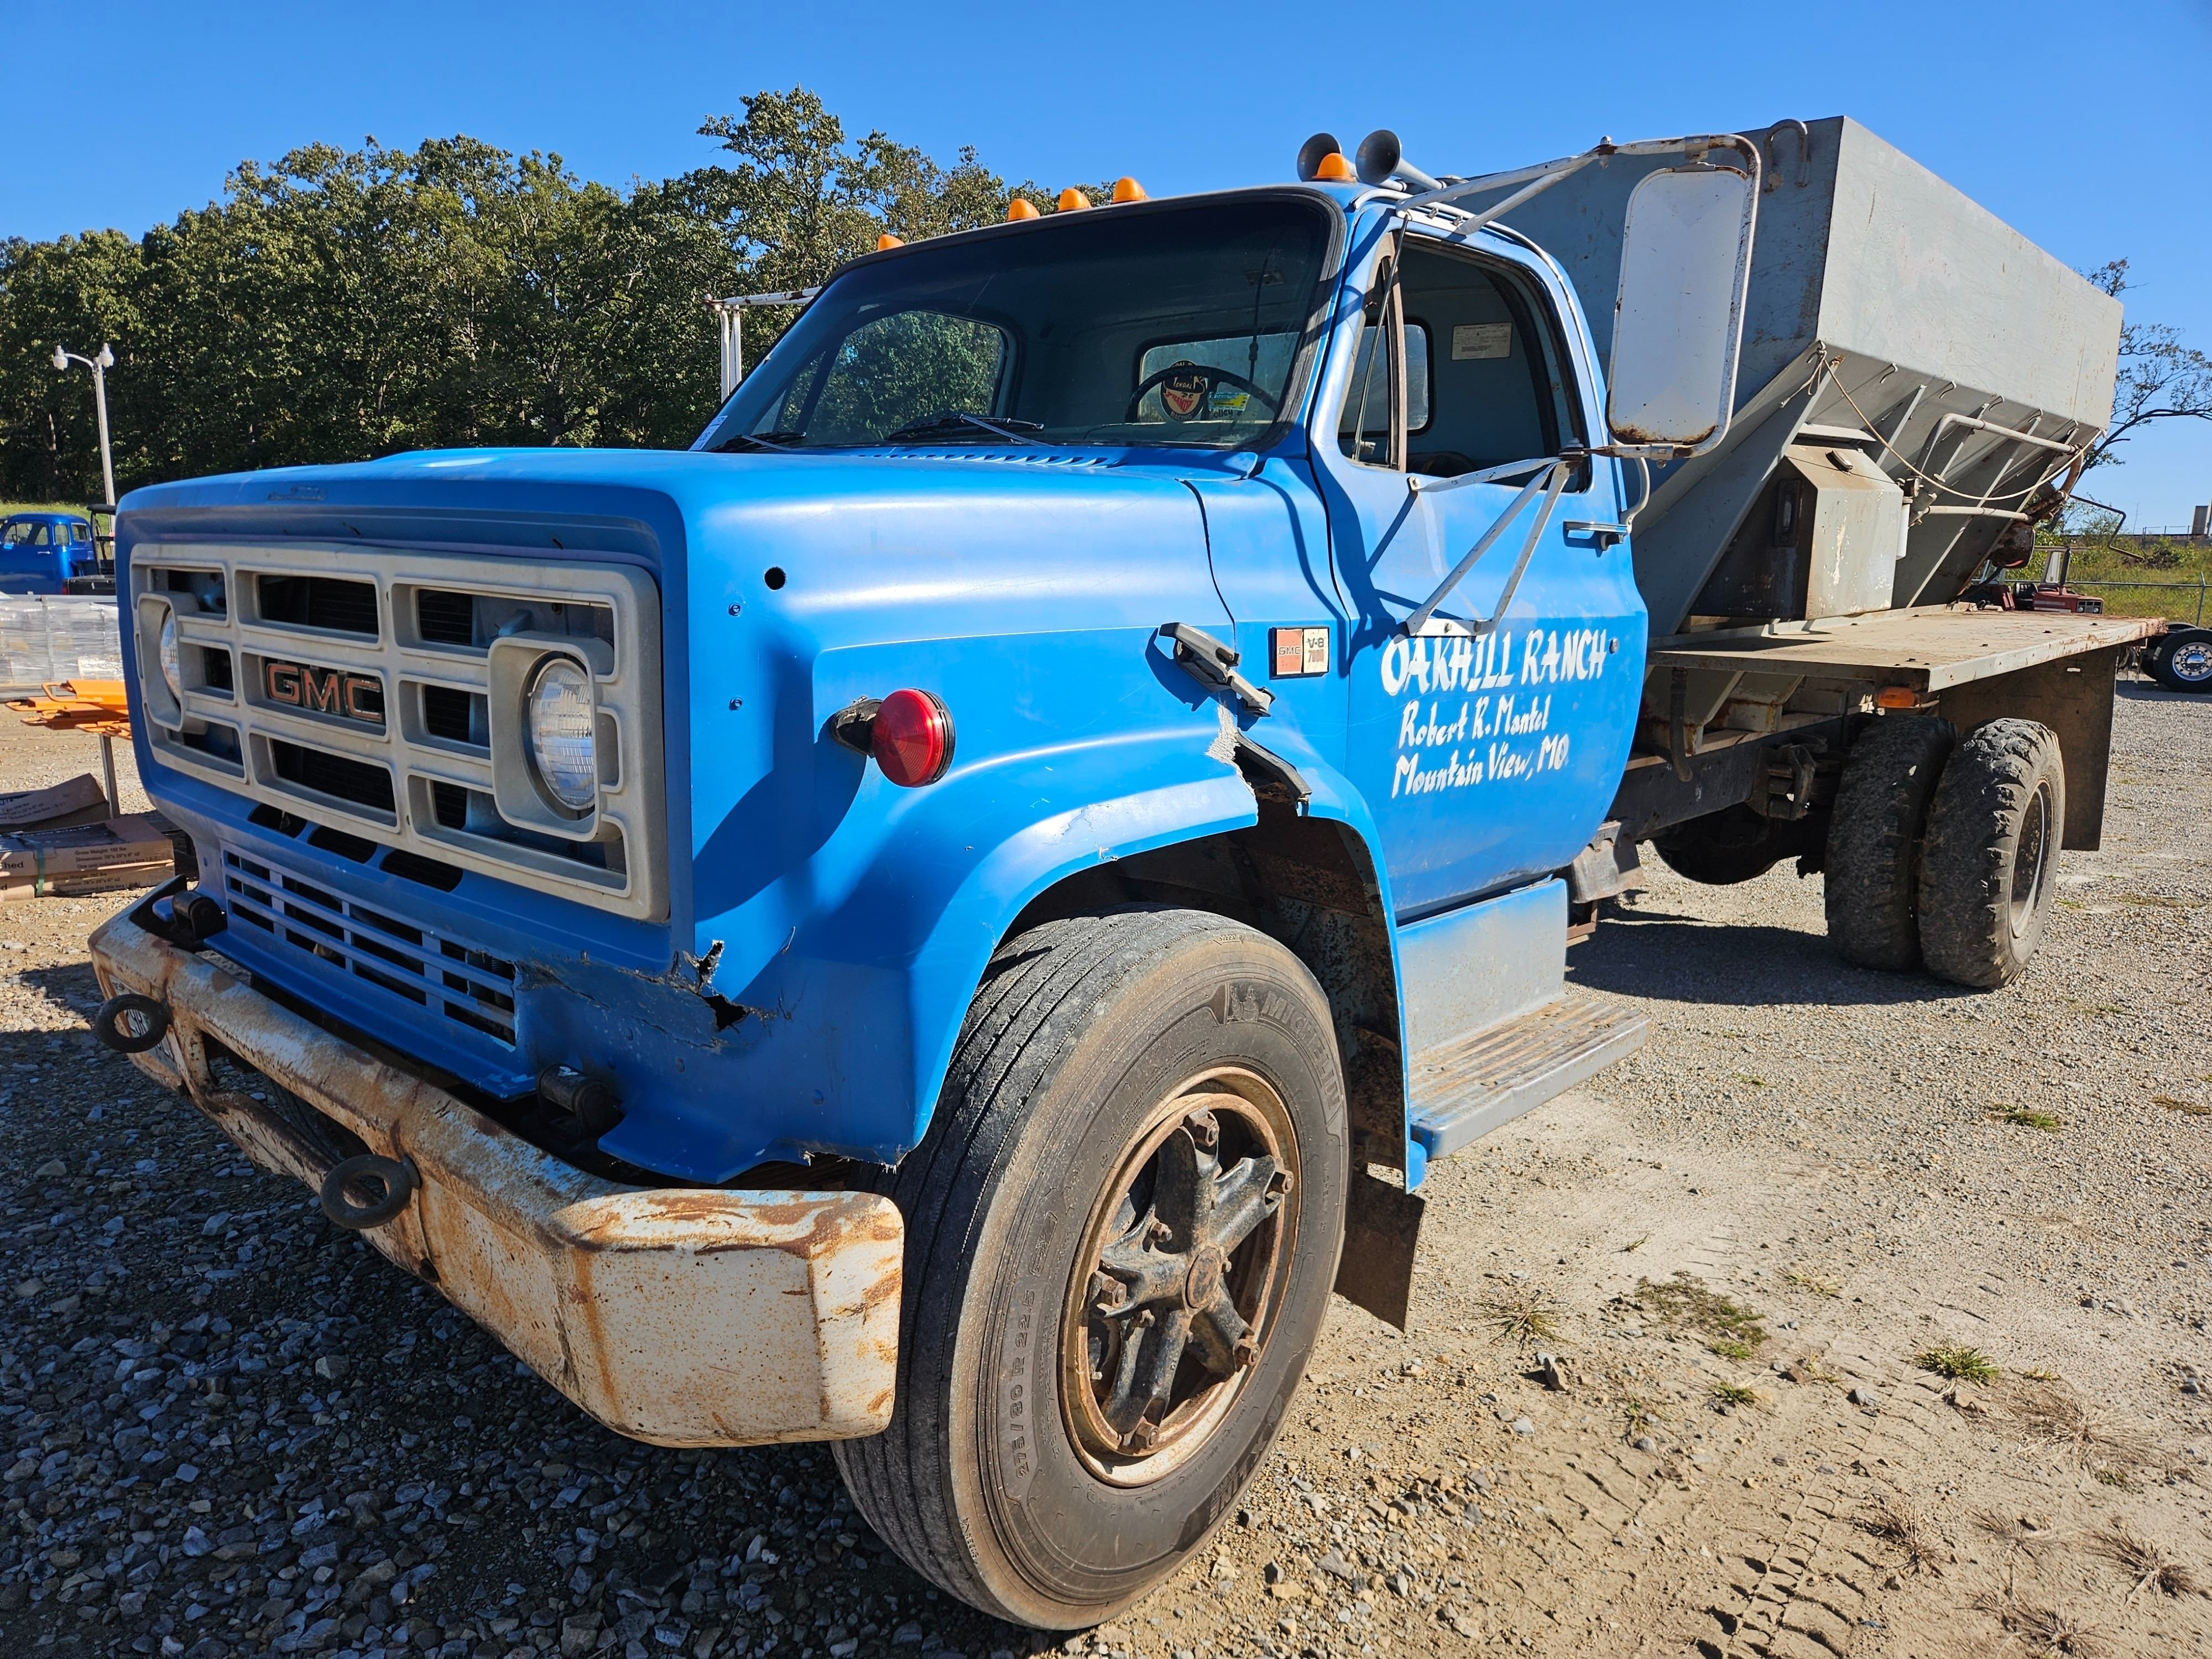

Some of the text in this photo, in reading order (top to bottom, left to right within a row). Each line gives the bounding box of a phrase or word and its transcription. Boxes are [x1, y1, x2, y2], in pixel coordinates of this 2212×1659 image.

[1170, 411, 1192, 421] RACING
[1279, 646, 1301, 655] GMC
[1382, 629, 1606, 696] OAKHILL RANCH
[266, 664, 383, 722] GMC
[1399, 700, 1468, 749] Robert
[1472, 696, 1491, 740] R.
[1391, 748, 1483, 799] Mountain
[1489, 741, 1534, 781] View,
[1260, 990, 1341, 1110] MICHELIN
[1014, 1289, 1035, 1348] 22.5
[1011, 1356, 1025, 1377] R
